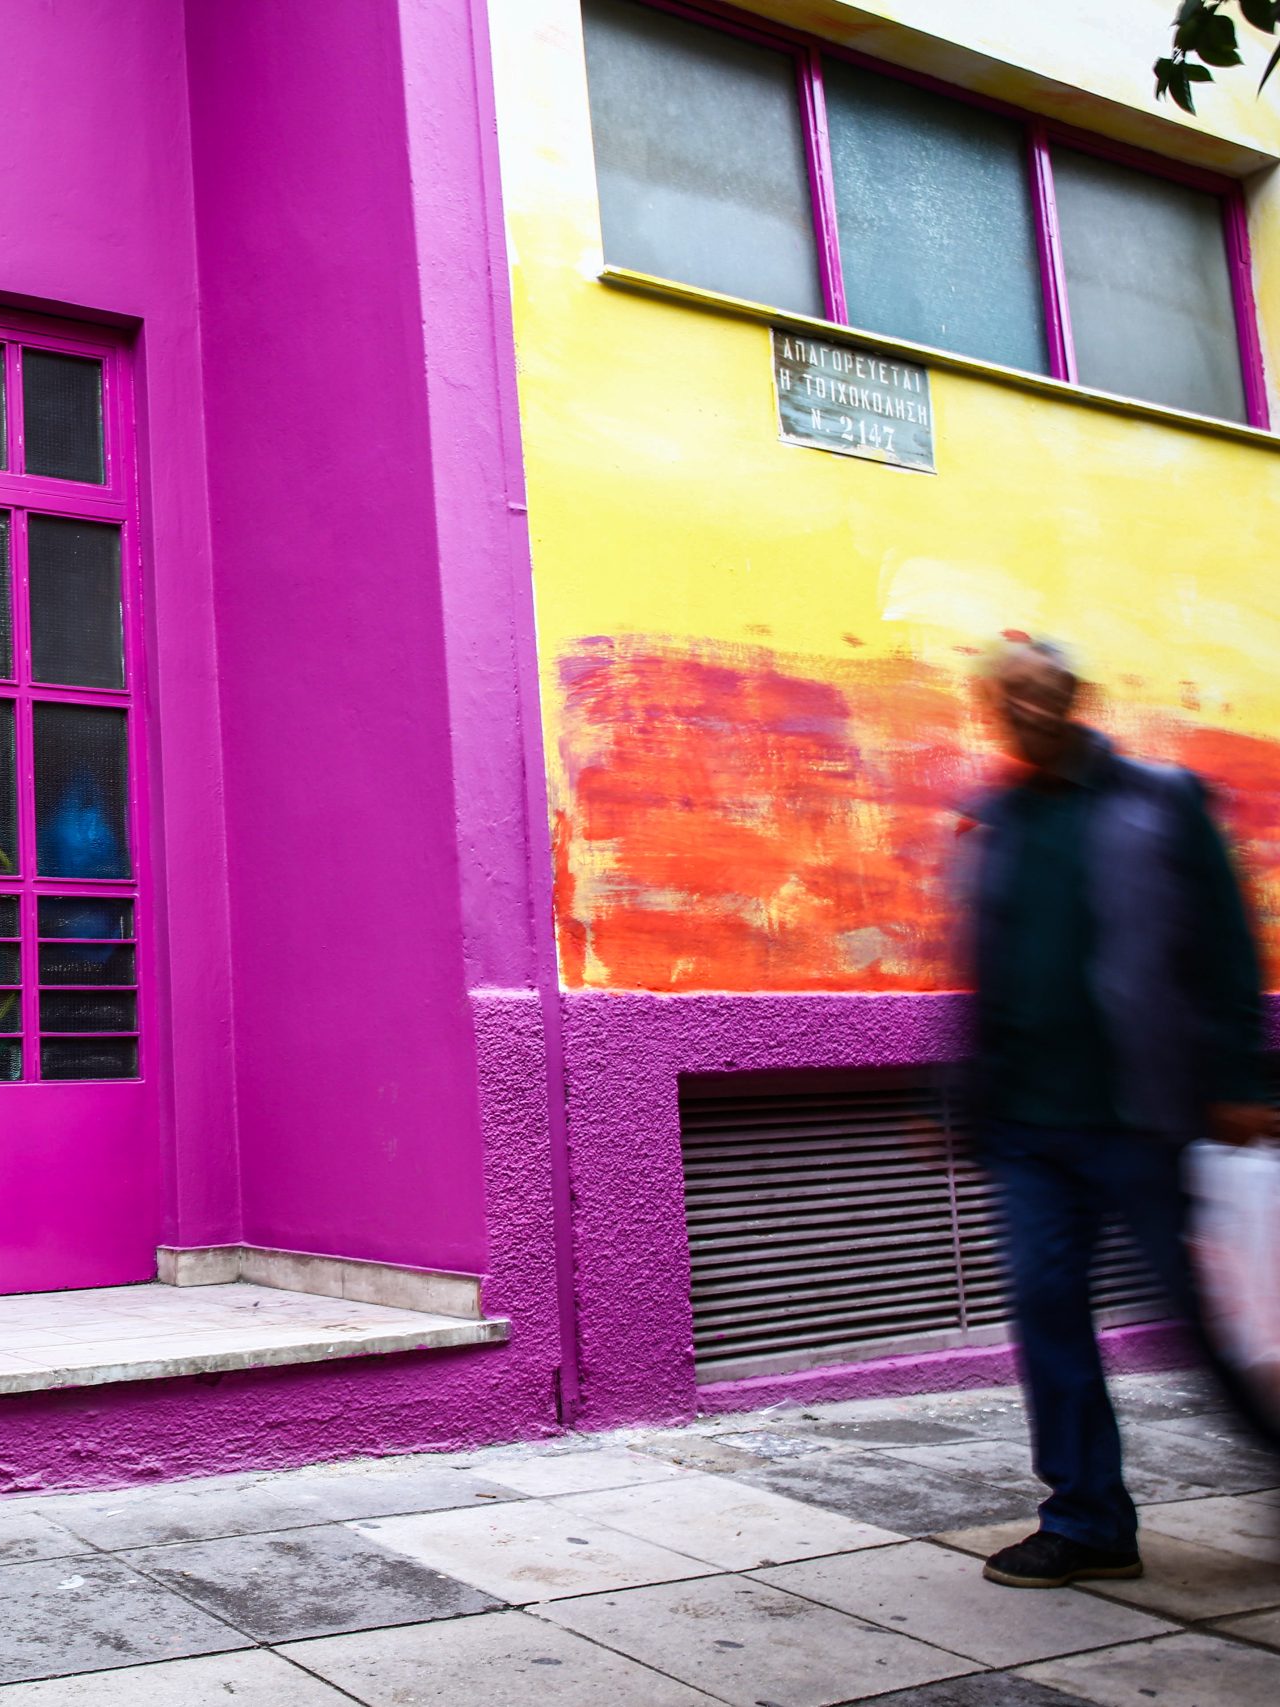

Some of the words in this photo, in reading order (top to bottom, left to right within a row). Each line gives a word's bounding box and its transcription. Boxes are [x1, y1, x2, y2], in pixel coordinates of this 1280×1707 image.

[783, 338, 920, 393] ΑΠΑΓΟΡΕΥΕΤΑΙ
[780, 368, 791, 391] Η
[802, 373, 928, 426] ΤΟΙΧΟΚΟΛΗΣΗ
[811, 408, 831, 433] Ν.
[839, 415, 896, 452] 2147
